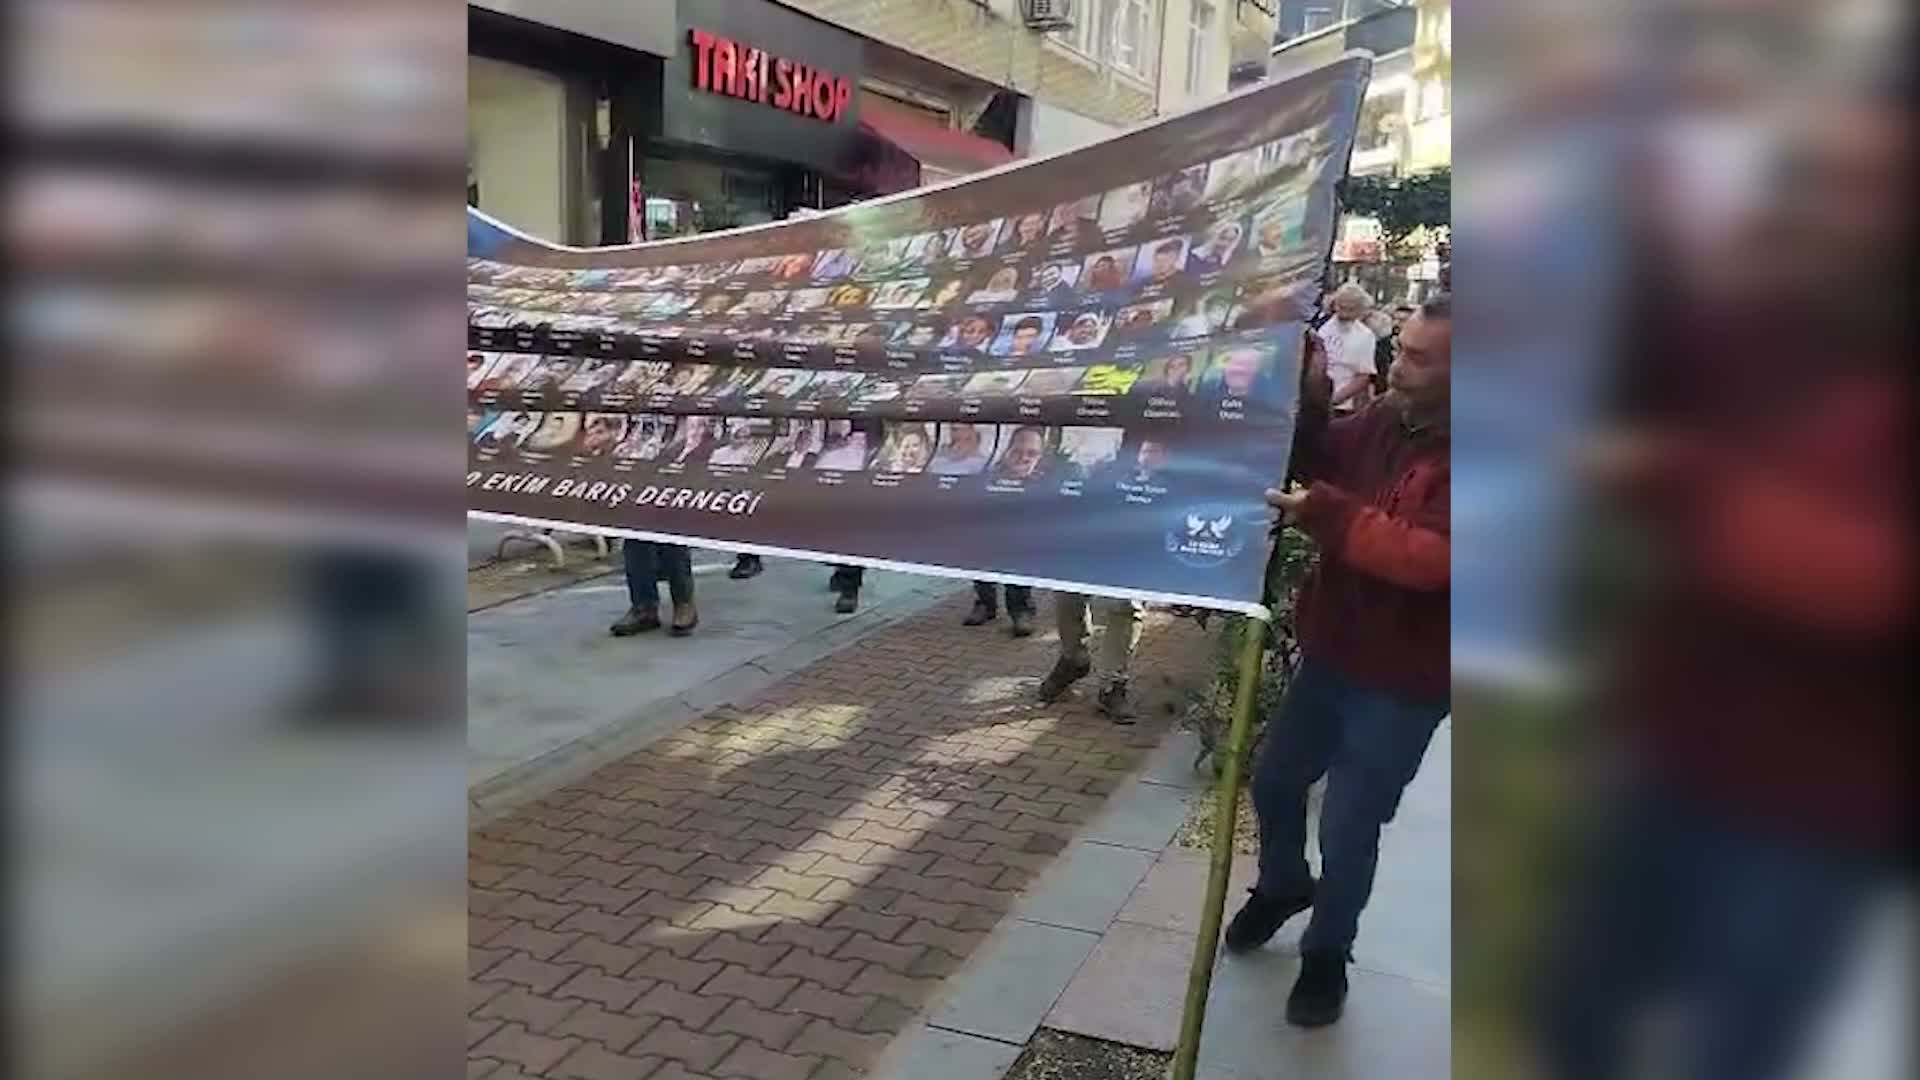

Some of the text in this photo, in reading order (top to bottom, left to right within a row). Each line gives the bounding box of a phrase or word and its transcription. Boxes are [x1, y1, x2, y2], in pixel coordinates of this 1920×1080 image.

[692, 30, 852, 121] TAKI SHOP
[483, 471, 551, 494] EKİM
[552, 479, 633, 509] BARIŞ
[635, 485, 765, 515] DERNEĞİ
